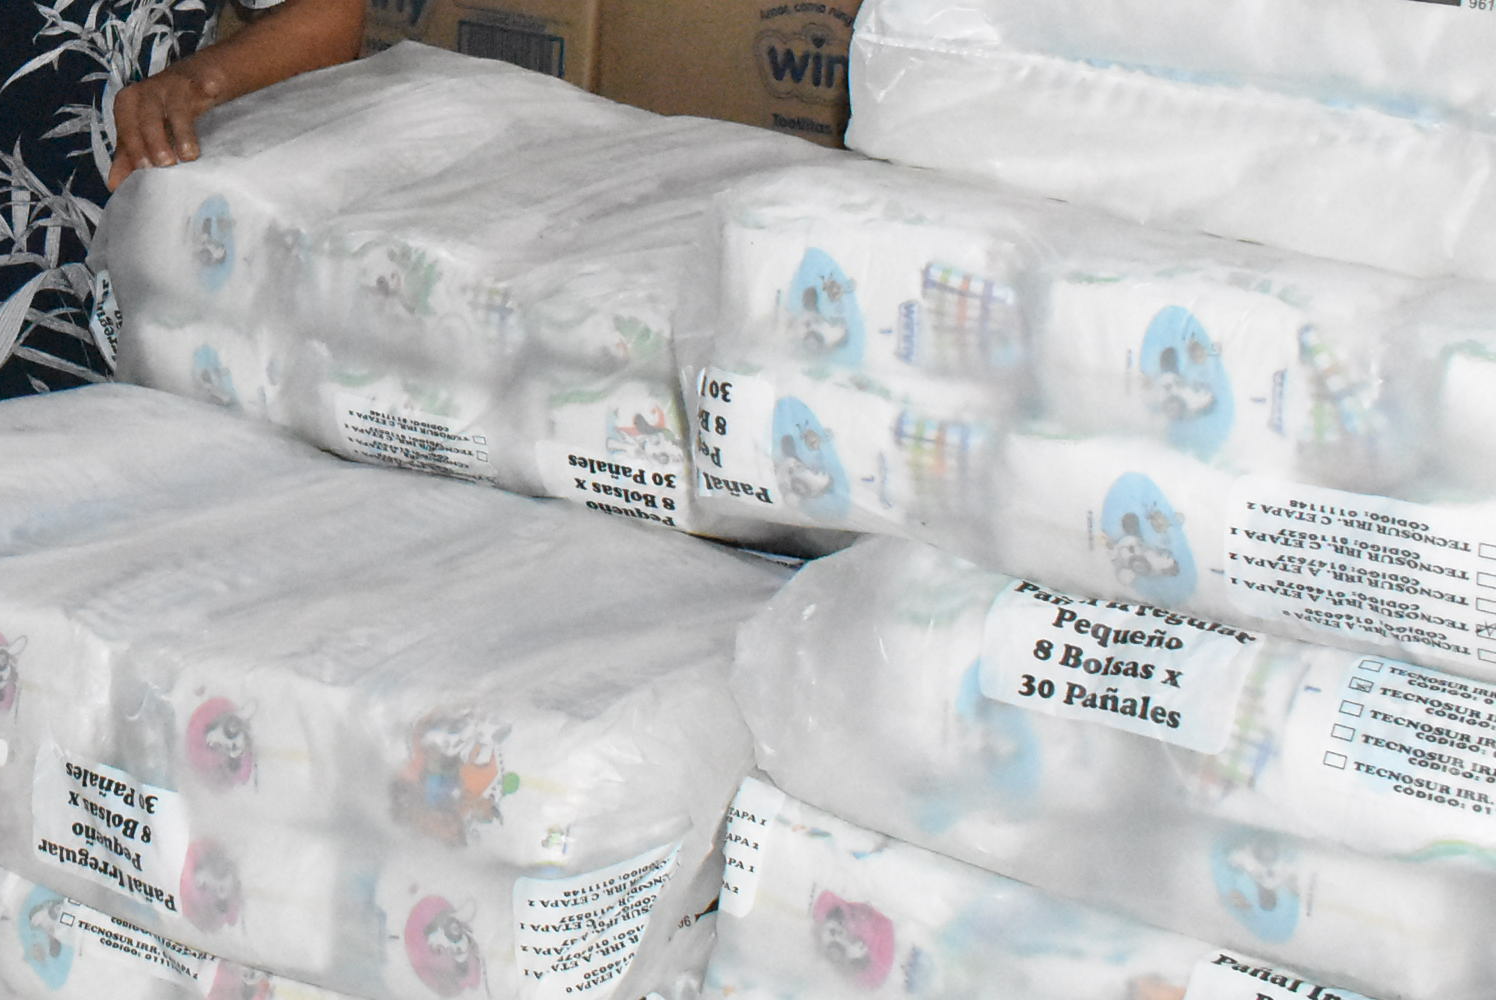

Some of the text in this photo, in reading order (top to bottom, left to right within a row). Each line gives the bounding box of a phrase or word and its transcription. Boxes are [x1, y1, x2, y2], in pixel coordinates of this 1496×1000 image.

[709, 380, 733, 403] 30
[715, 415, 727, 436] 8
[568, 454, 676, 489] 30 Pañales
[702, 471, 773, 504] Pañal
[574, 478, 675, 511] 8 Bolsas x
[1290, 500, 1358, 517] 0111148
[1246, 501, 1471, 552] TECNOSUR IRR. C ETAPA 2
[1278, 528, 1349, 545] 0110527
[1229, 527, 1470, 580] TECNOSUR IRR. C ETAPA 1
[1277, 555, 1347, 573] 0147637
[1228, 552, 1470, 606] TECNOSUR IRR. A ETAPA 2
[1276, 579, 1349, 597] 0146078
[1229, 577, 1470, 631] TECNOSUR IRR. A ETAPA 1
[1294, 612, 1345, 629] ETAPA
[1052, 607, 1184, 651] Pequeño
[1390, 633, 1471, 656] TECNOSUR
[1033, 639, 1184, 687] 8 Bolsas x
[1389, 666, 1470, 692] TECNOSUR
[1018, 674, 1182, 729] 30 Pañales
[1379, 687, 1482, 719] TECNOSUR
[1369, 710, 1471, 743] TECNOSUR
[1361, 734, 1464, 769] TECNOSUR
[65, 761, 135, 808] Pañales
[1353, 761, 1494, 806] TECNOSUR IRR.
[68, 790, 152, 844] 8 Bolsas x
[71, 822, 143, 873] Pequeño
[38, 838, 178, 913] Pañal Irregular
[541, 897, 589, 908] ETAPA
[78, 920, 133, 947] TECNOSUR
[576, 971, 613, 991] ETAPA
[1211, 954, 1304, 993] Pañal
